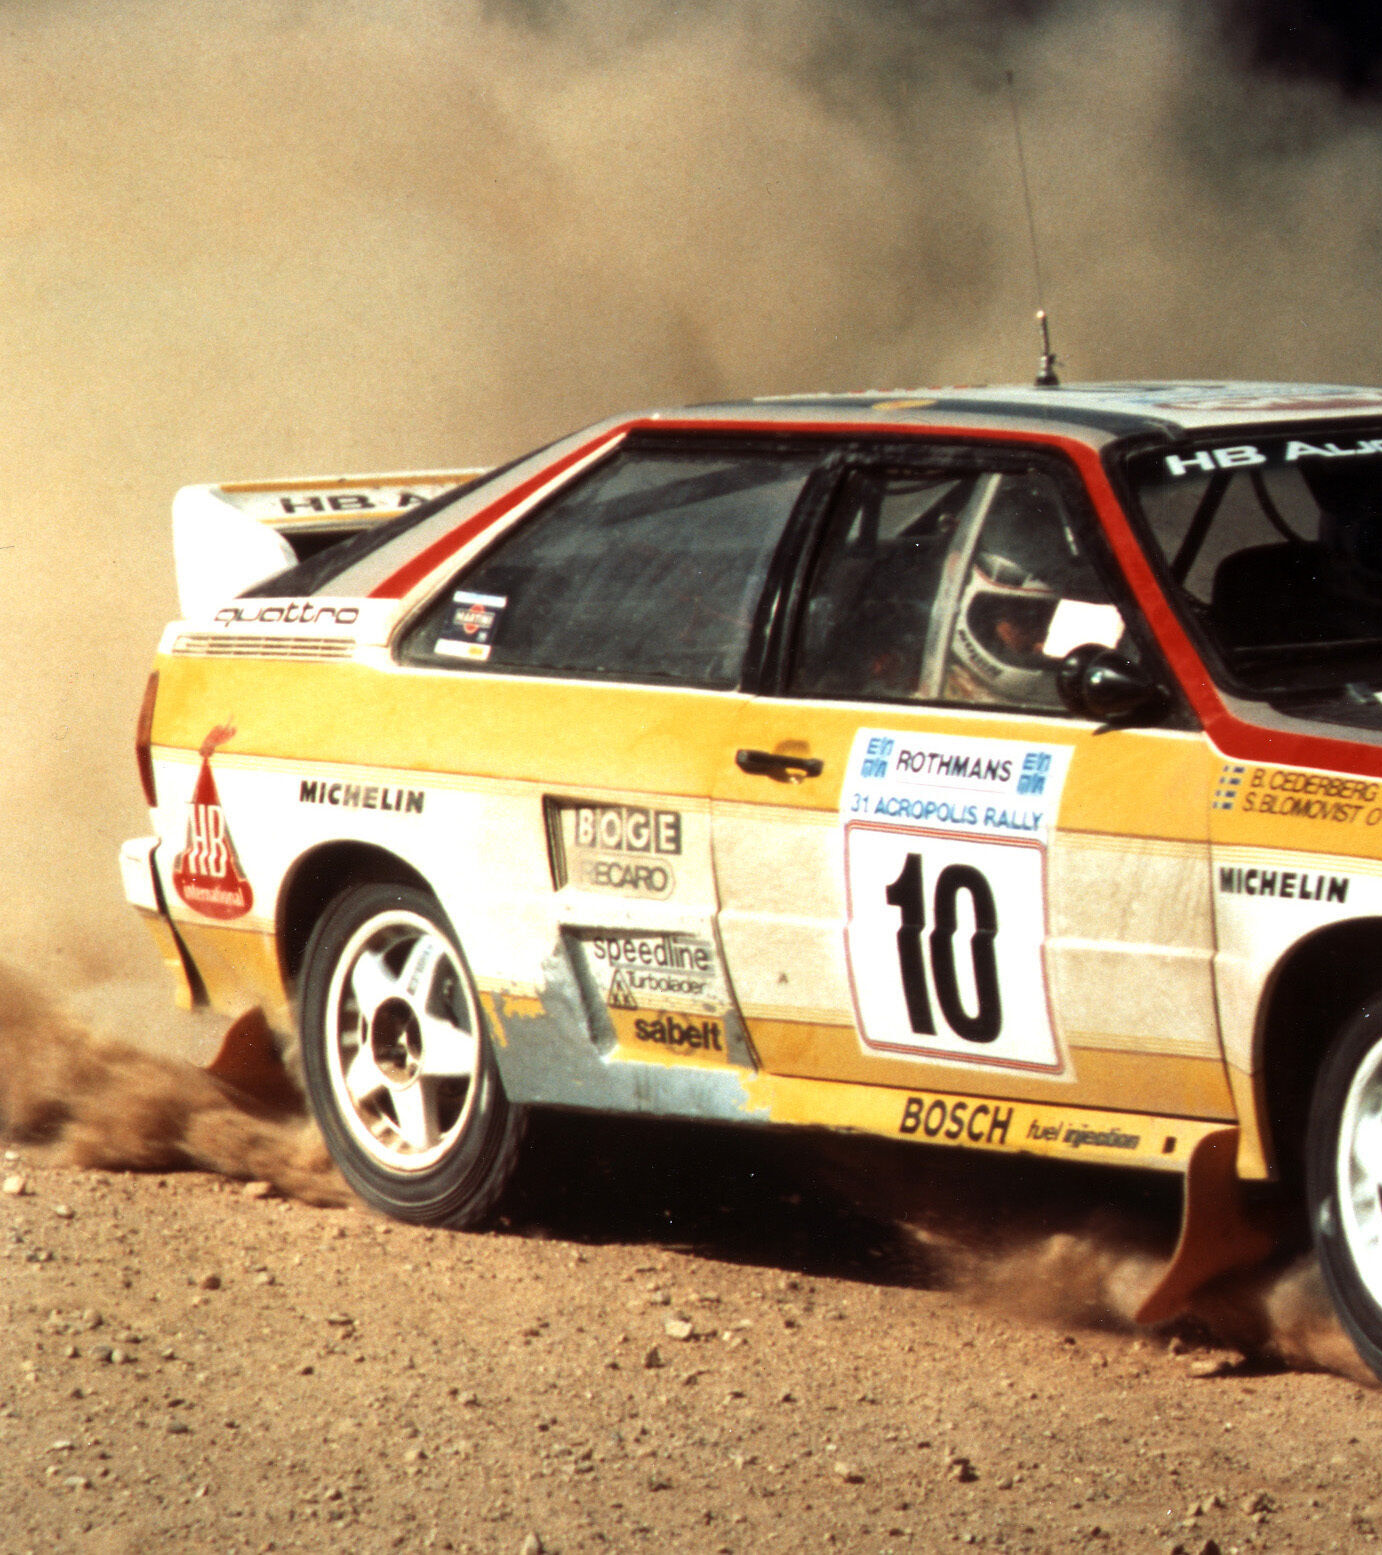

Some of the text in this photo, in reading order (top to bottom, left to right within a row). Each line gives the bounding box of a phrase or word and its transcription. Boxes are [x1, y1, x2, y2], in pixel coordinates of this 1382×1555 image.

[1165, 444, 1267, 476] HB
[279, 494, 374, 514] HB
[213, 601, 359, 628] quattro
[896, 749, 1013, 783] ROTHMANS
[299, 779, 425, 815] MICHELIN
[850, 792, 1043, 832] 31 ACROPOLIS RALLY
[187, 803, 228, 878] HB
[577, 807, 679, 854] BOGE
[1218, 866, 1350, 903] MICHELIN
[594, 936, 712, 972] speedline
[885, 852, 1003, 1045] 10
[634, 1016, 723, 1051] sabelt
[899, 1096, 1142, 1149] BOSCH fuel injection
